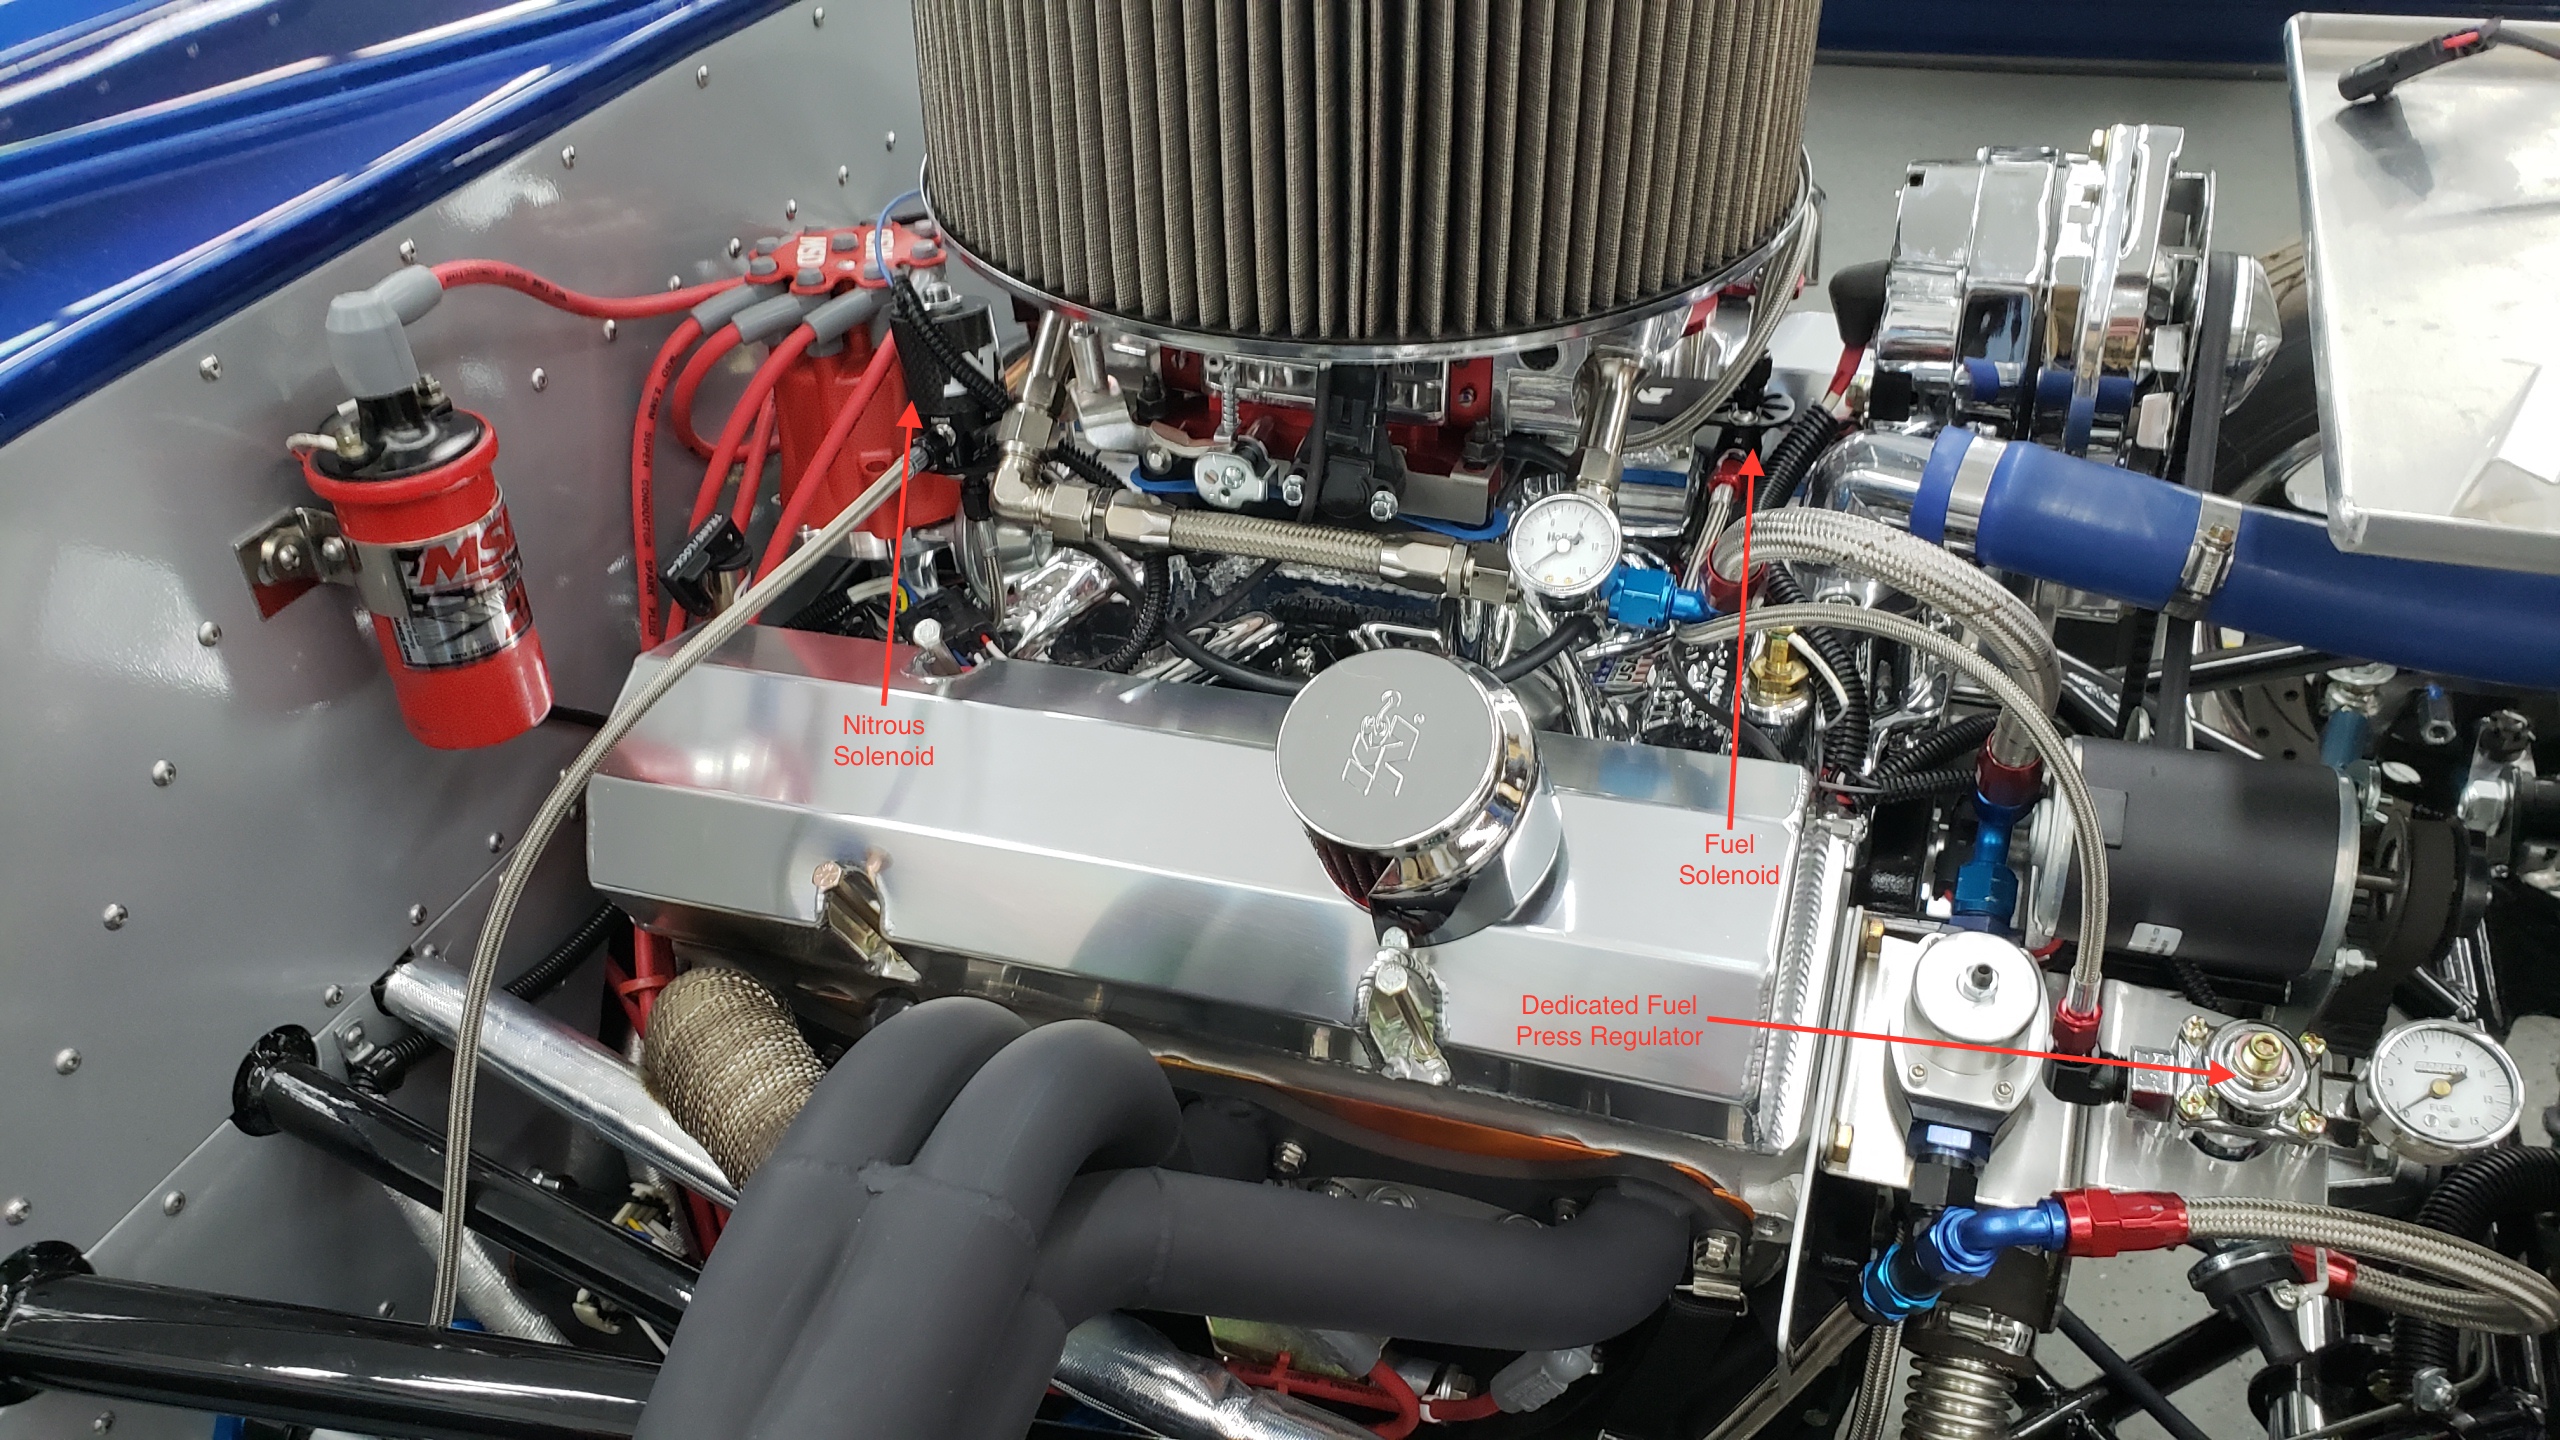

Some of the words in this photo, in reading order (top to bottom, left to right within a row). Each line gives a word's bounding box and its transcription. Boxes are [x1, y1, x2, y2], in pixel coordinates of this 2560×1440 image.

[797, 236, 827, 267] MSD
[643, 431, 652, 468] SUPER
[641, 479, 651, 548] CONDUCTOR
[644, 560, 655, 596] SPARK
[1579, 566, 1587, 576] 15
[648, 607, 658, 637] PLUG
[2388, 1078, 2394, 1087] 3
[2429, 1103, 2455, 1113] FUEL
[2484, 1095, 2494, 1104] 13
[2470, 1116, 2479, 1125] 15
